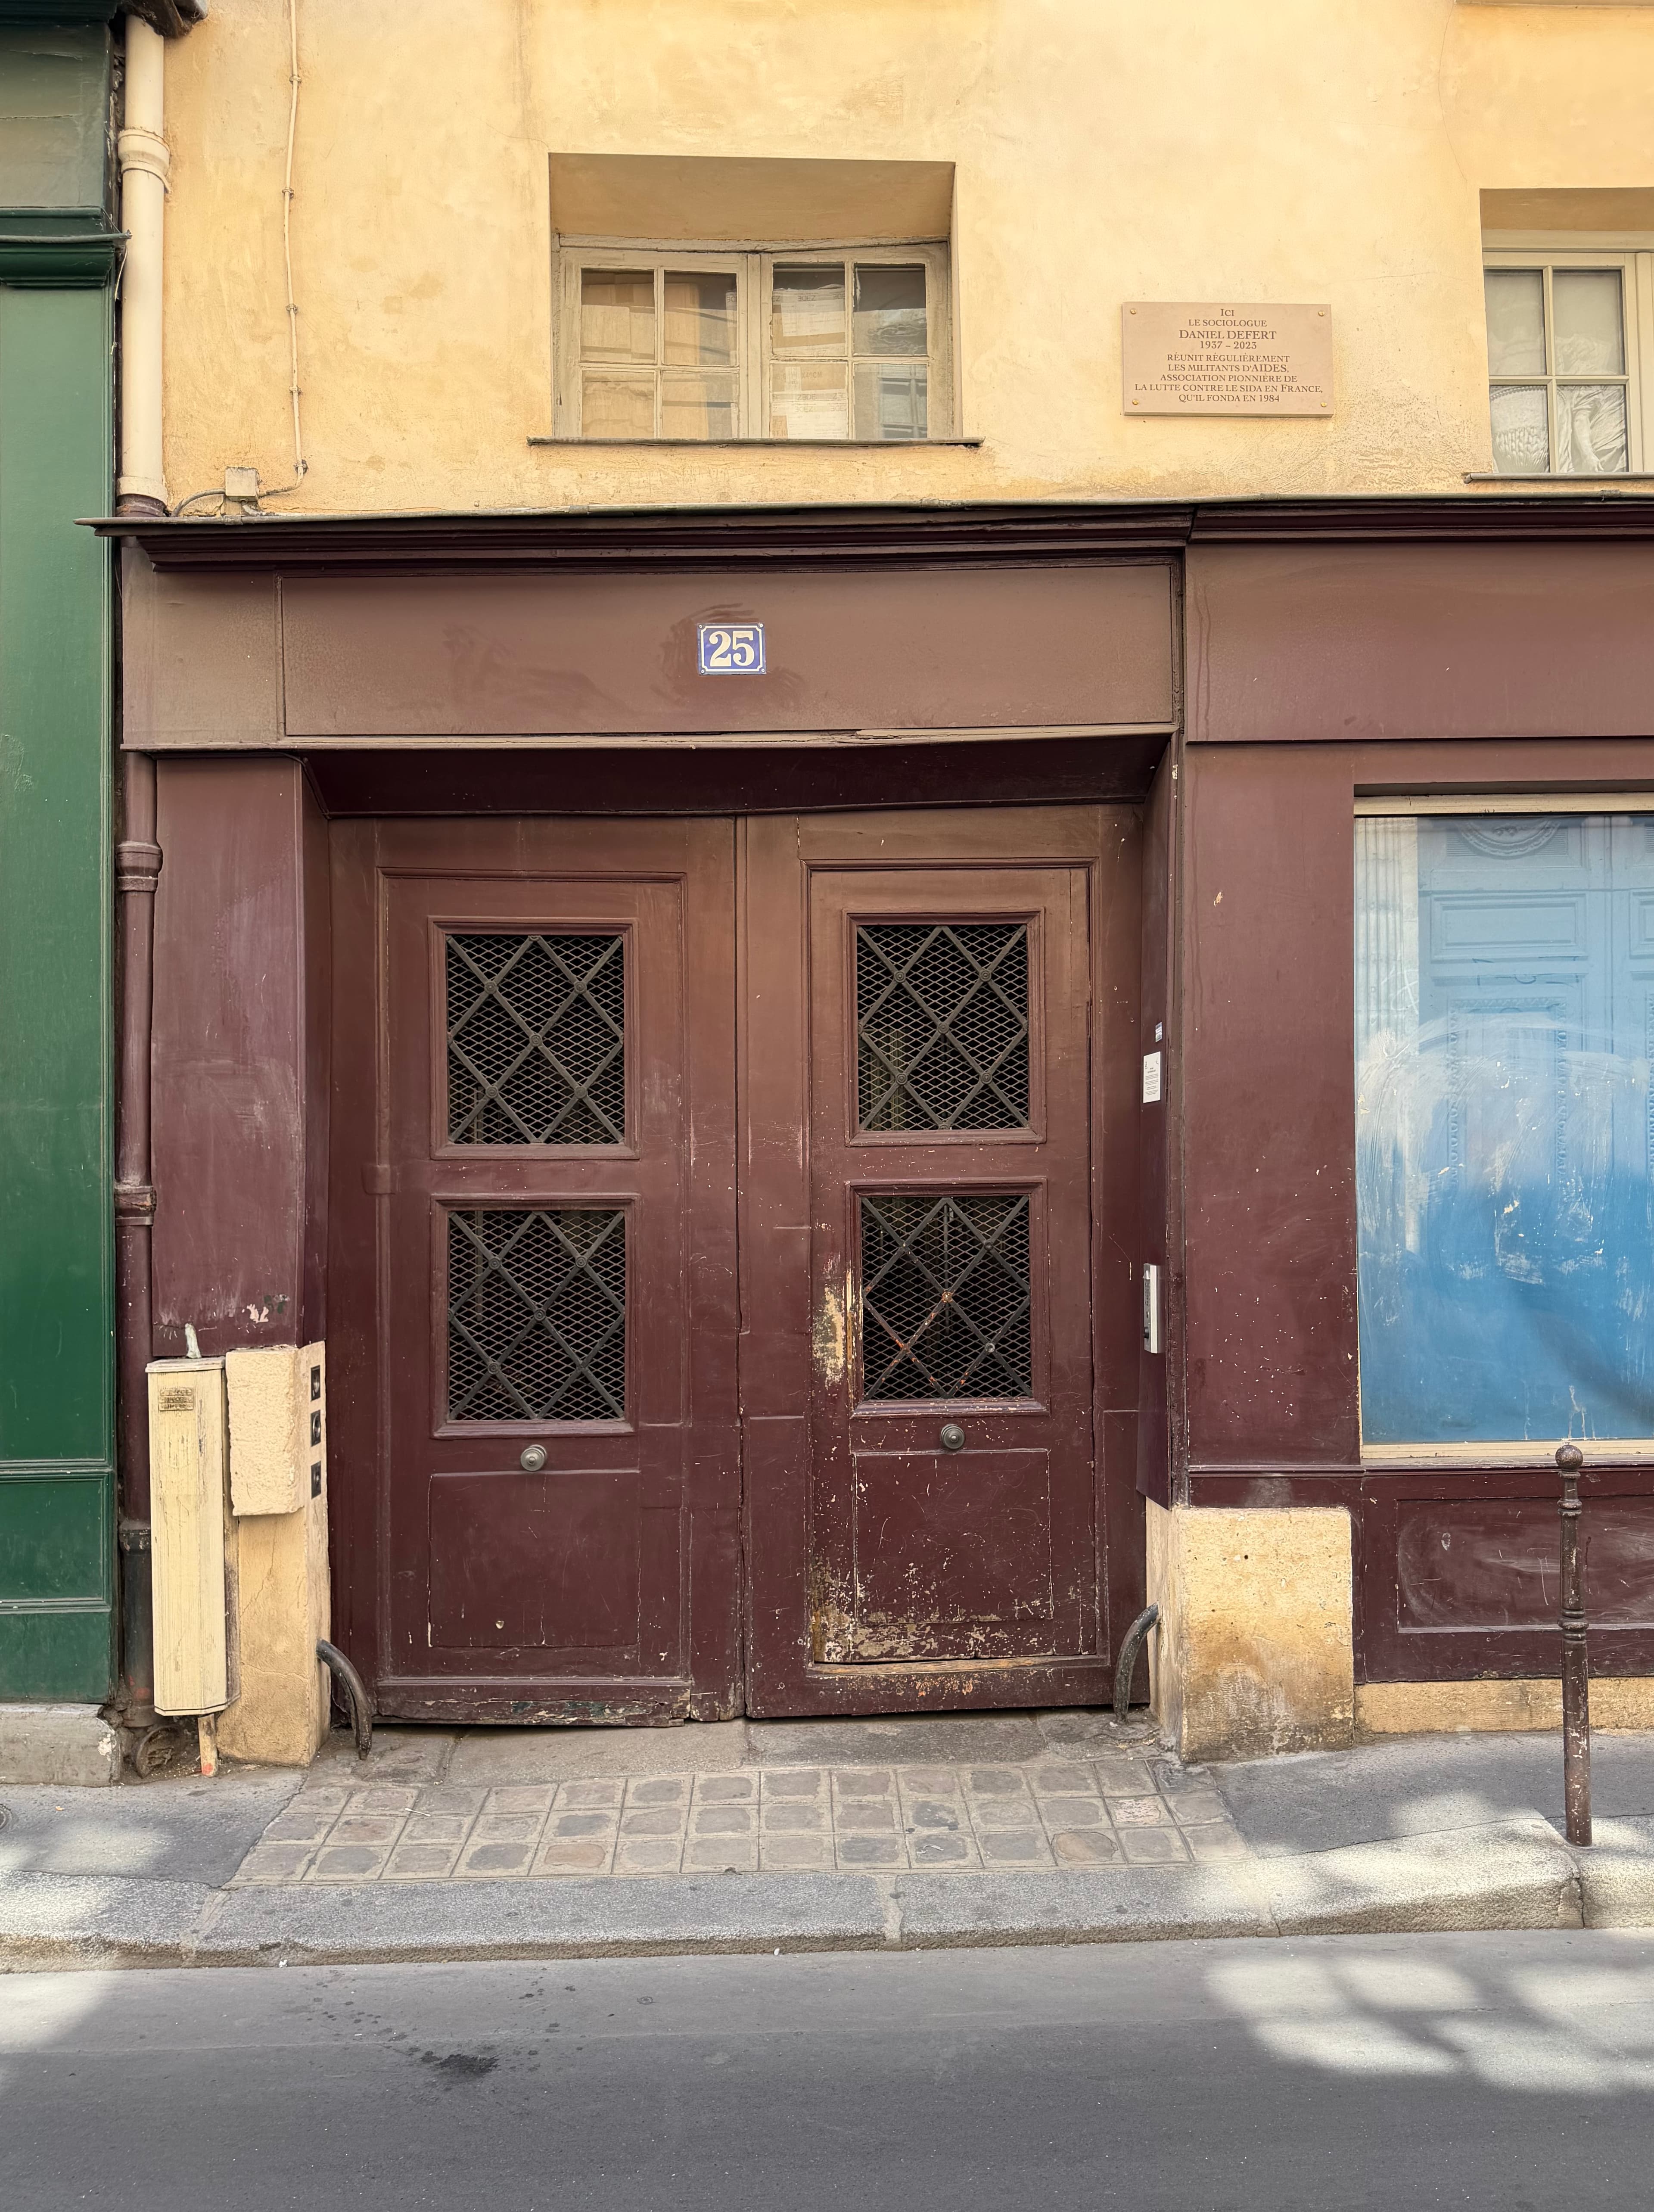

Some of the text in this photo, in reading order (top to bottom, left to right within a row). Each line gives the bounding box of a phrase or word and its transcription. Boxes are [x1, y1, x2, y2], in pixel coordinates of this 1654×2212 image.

[1179, 330, 1277, 340] DANIEL DEFERT
[1200, 341, 1223, 349] 1937
[1233, 341, 1257, 350] 2023
[1167, 352, 1290, 363] RÉUNIT RÉGULIÈREMENT
[1228, 373, 1282, 382] PIONNIÈRE
[1178, 394, 1205, 403] QU'IL
[1259, 394, 1279, 402] 1984
[709, 631, 755, 667] 25
